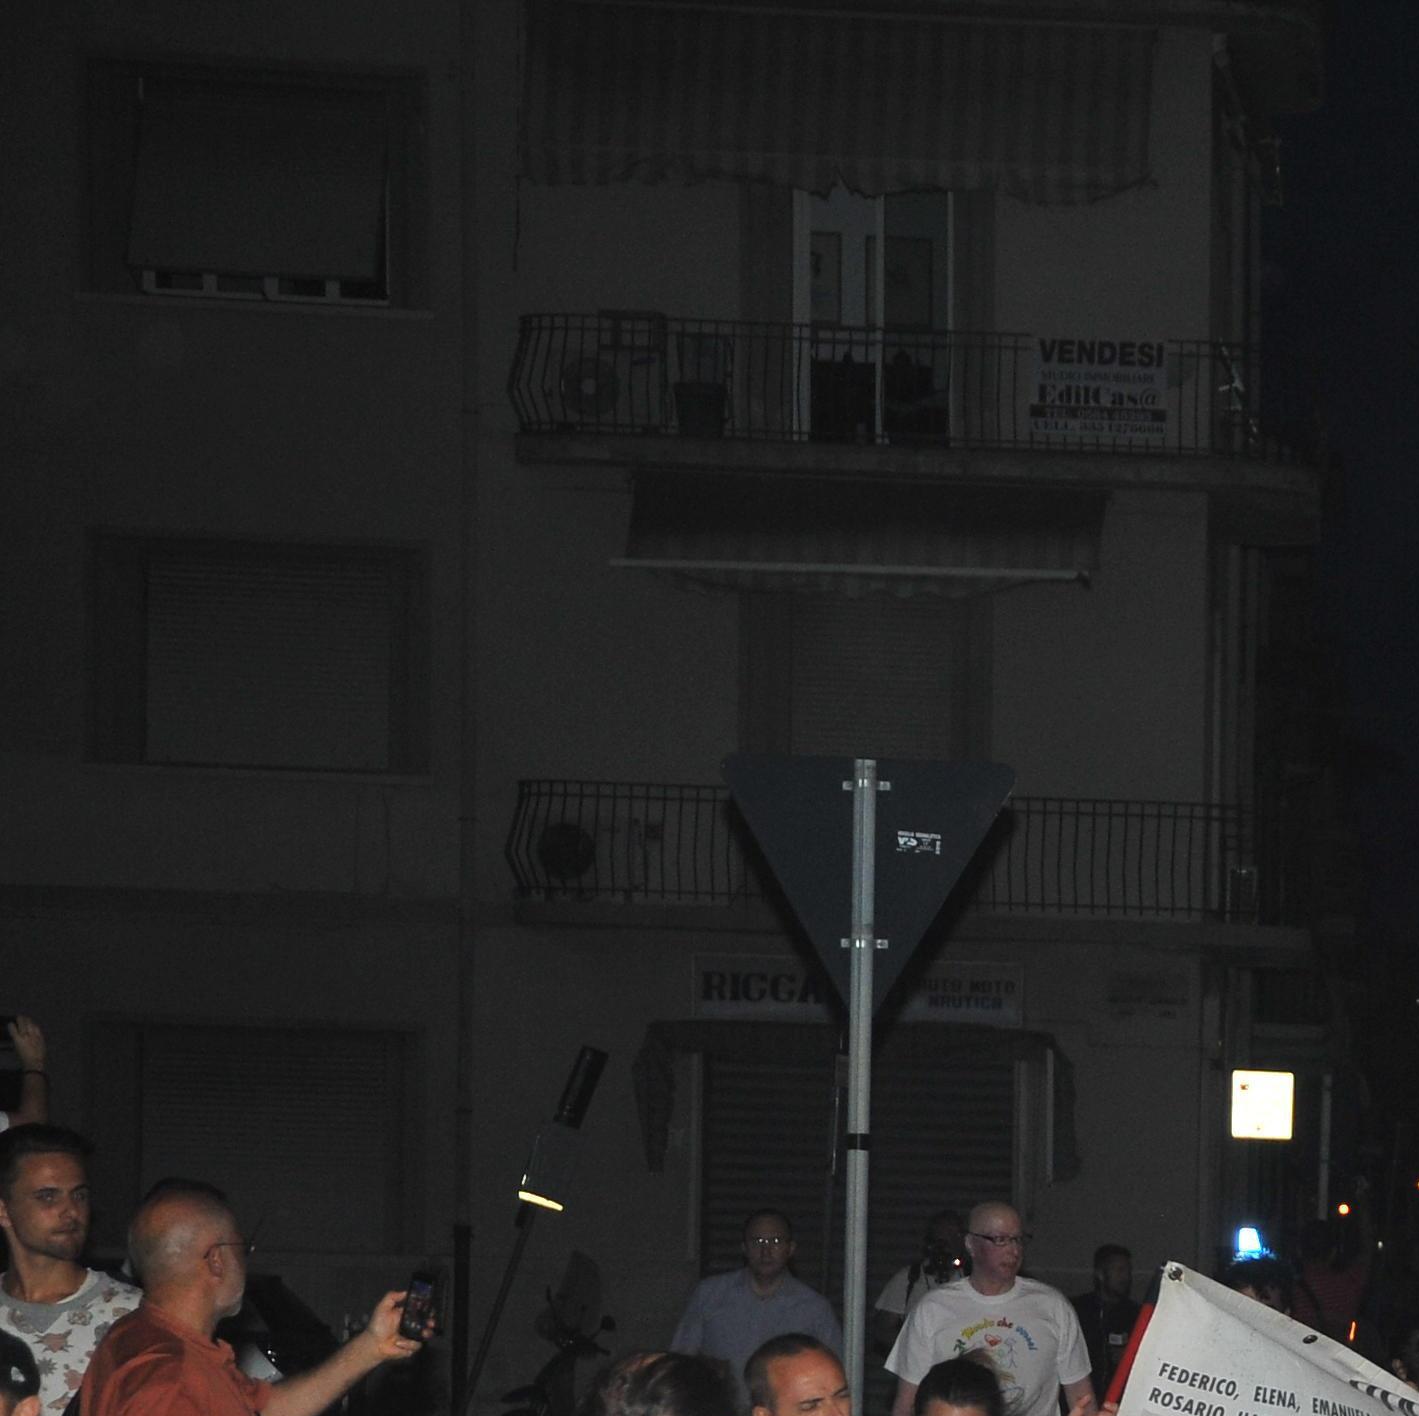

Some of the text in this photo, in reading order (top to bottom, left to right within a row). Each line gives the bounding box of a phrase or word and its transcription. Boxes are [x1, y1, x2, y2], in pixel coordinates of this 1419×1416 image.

[1039, 339, 1164, 367] VENDESI
[1158, 1362, 1240, 1400] FEDERICO,
[1253, 1386, 1302, 1413] ELENA,
